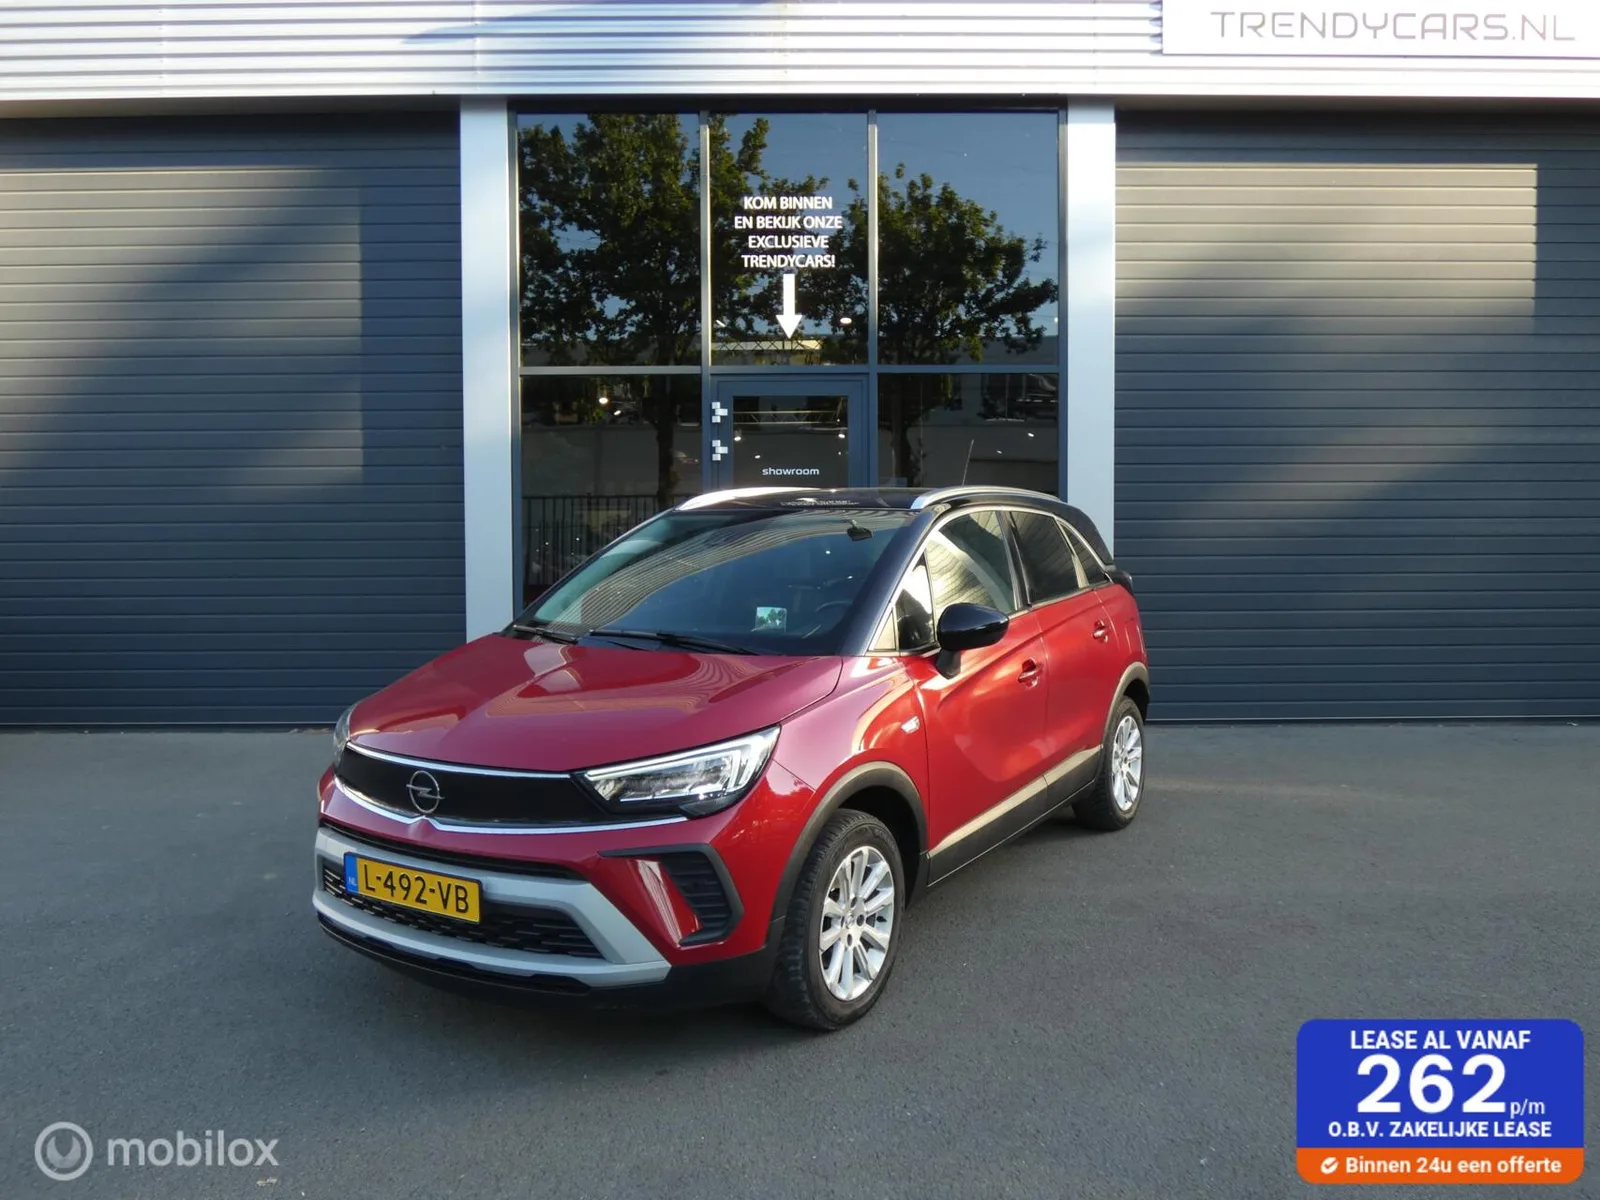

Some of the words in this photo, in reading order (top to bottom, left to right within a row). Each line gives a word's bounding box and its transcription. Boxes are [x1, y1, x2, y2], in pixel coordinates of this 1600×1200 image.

[1210, 12, 1576, 41] TRENDYCARS.NL
[743, 196, 777, 210] KOM
[780, 196, 833, 210] BINNEN
[734, 216, 754, 229] EN
[756, 216, 801, 229] BEKIJK
[803, 216, 843, 229] ONZE
[748, 235, 829, 249] EXCLUSIEVE
[741, 254, 836, 268] TRENDYCARS!
[762, 467, 820, 476] showroom
[363, 864, 469, 914] L-492-VB
